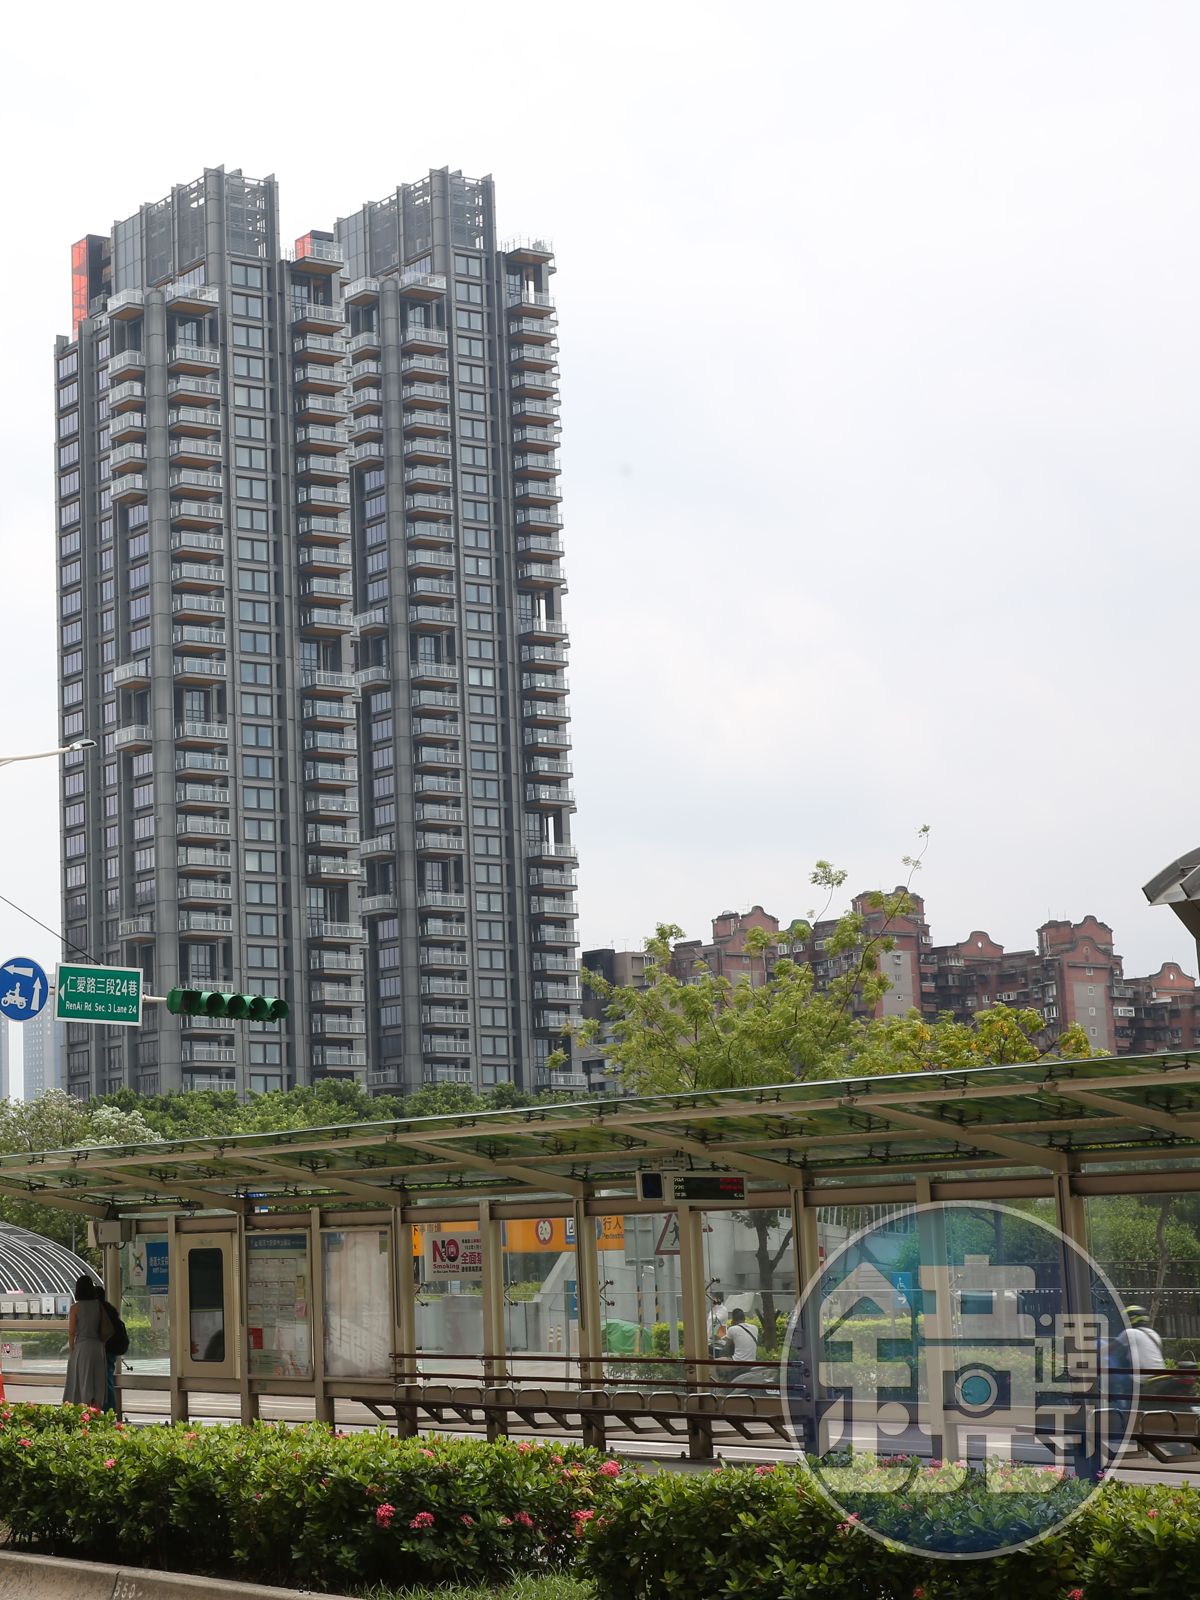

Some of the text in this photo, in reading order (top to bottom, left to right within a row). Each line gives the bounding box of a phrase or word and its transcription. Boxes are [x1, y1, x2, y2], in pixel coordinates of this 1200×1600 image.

[67, 976, 138, 997] 仁愛路三段24巷
[65, 1001, 83, 1010] RenAi
[108, 1003, 112, 1013] 3
[113, 1004, 127, 1014] Lane
[128, 1005, 137, 1014] 24
[432, 1239, 460, 1263] NO
